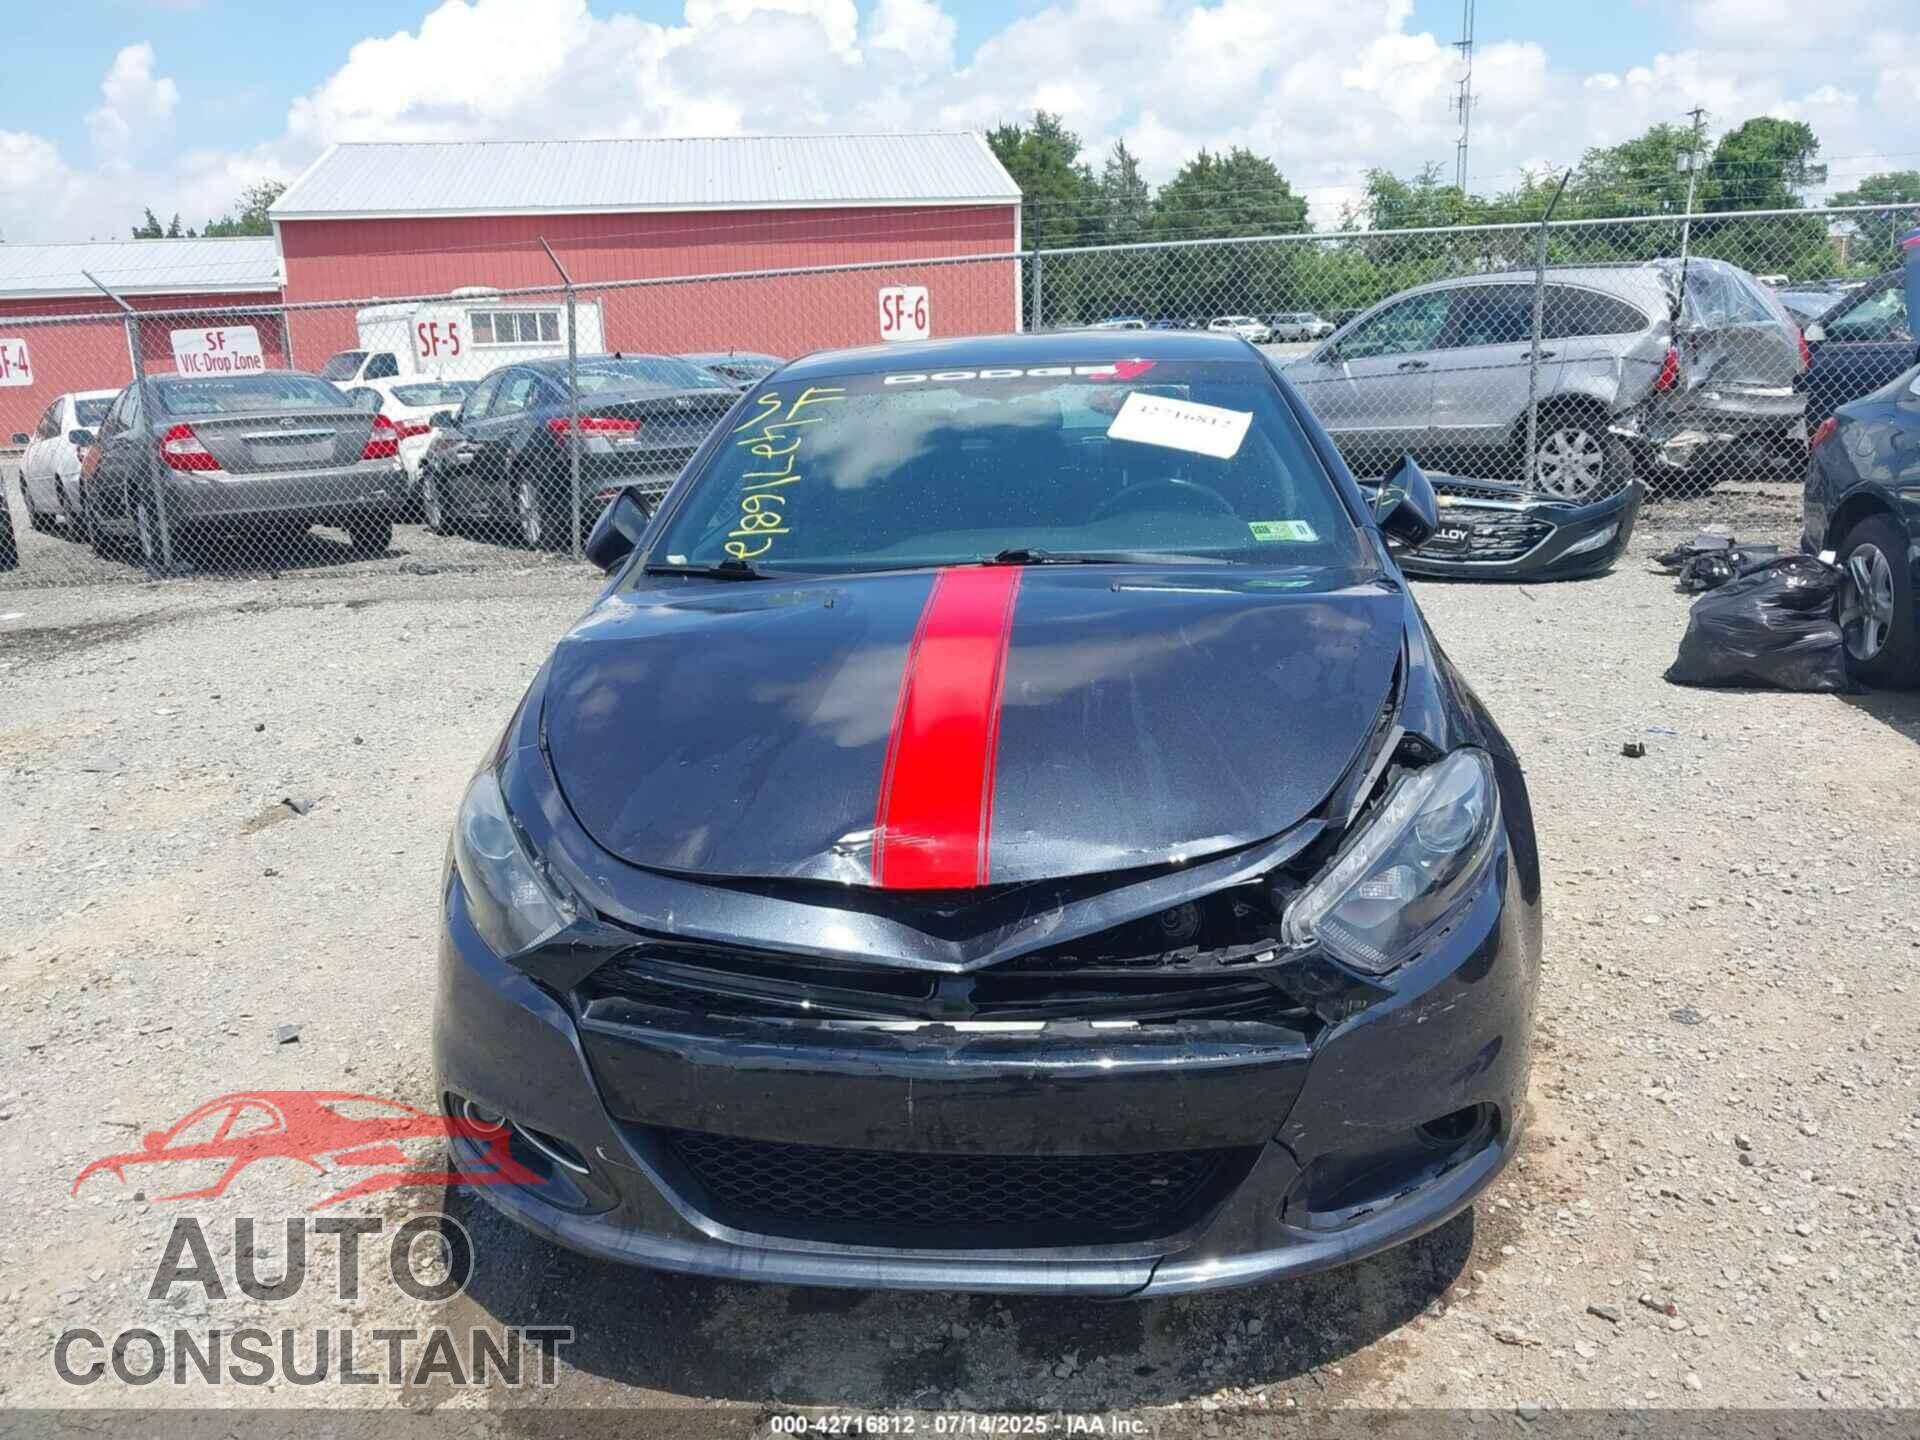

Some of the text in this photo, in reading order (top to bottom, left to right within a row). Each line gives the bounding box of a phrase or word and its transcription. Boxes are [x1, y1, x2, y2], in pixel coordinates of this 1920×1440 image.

[883, 294, 926, 331] SF-6
[205, 331, 226, 351] SF
[418, 322, 460, 357] SF-5
[0, 345, 29, 378] F-4
[180, 351, 261, 373] VIC-Drop Zone
